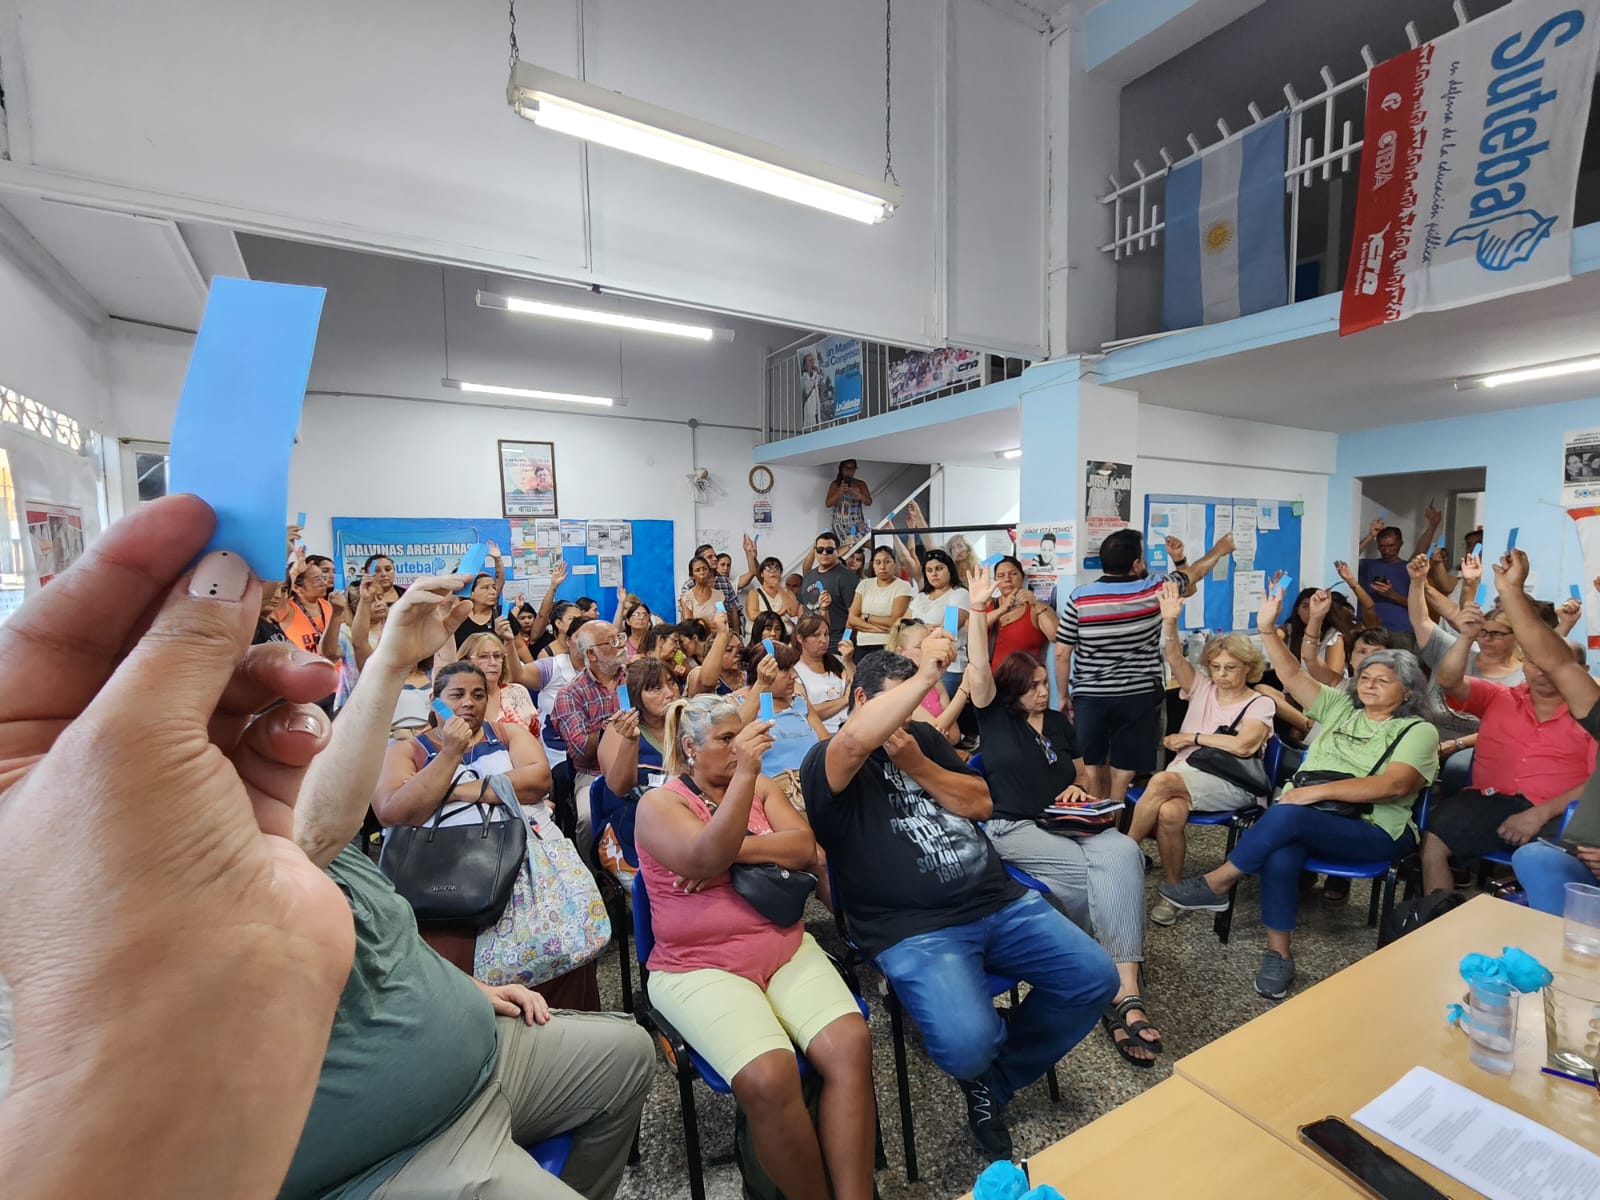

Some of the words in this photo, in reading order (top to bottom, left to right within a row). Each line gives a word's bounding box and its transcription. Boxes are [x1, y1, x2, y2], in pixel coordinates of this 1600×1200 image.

[1450, 61, 1460, 76] en
[1441, 80, 1464, 124] defensa
[1467, 8, 1586, 219] Suteba
[1440, 144, 1457, 158] la
[1442, 127, 1457, 141] de
[1372, 130, 1398, 192] CTERA
[1431, 161, 1452, 219] educación
[1422, 222, 1442, 264] pública
[1362, 237, 1385, 296] CTA
[345, 544, 404, 556] MALVINAS
[395, 559, 432, 574] uteba
[916, 848, 959, 874] SOLARI
